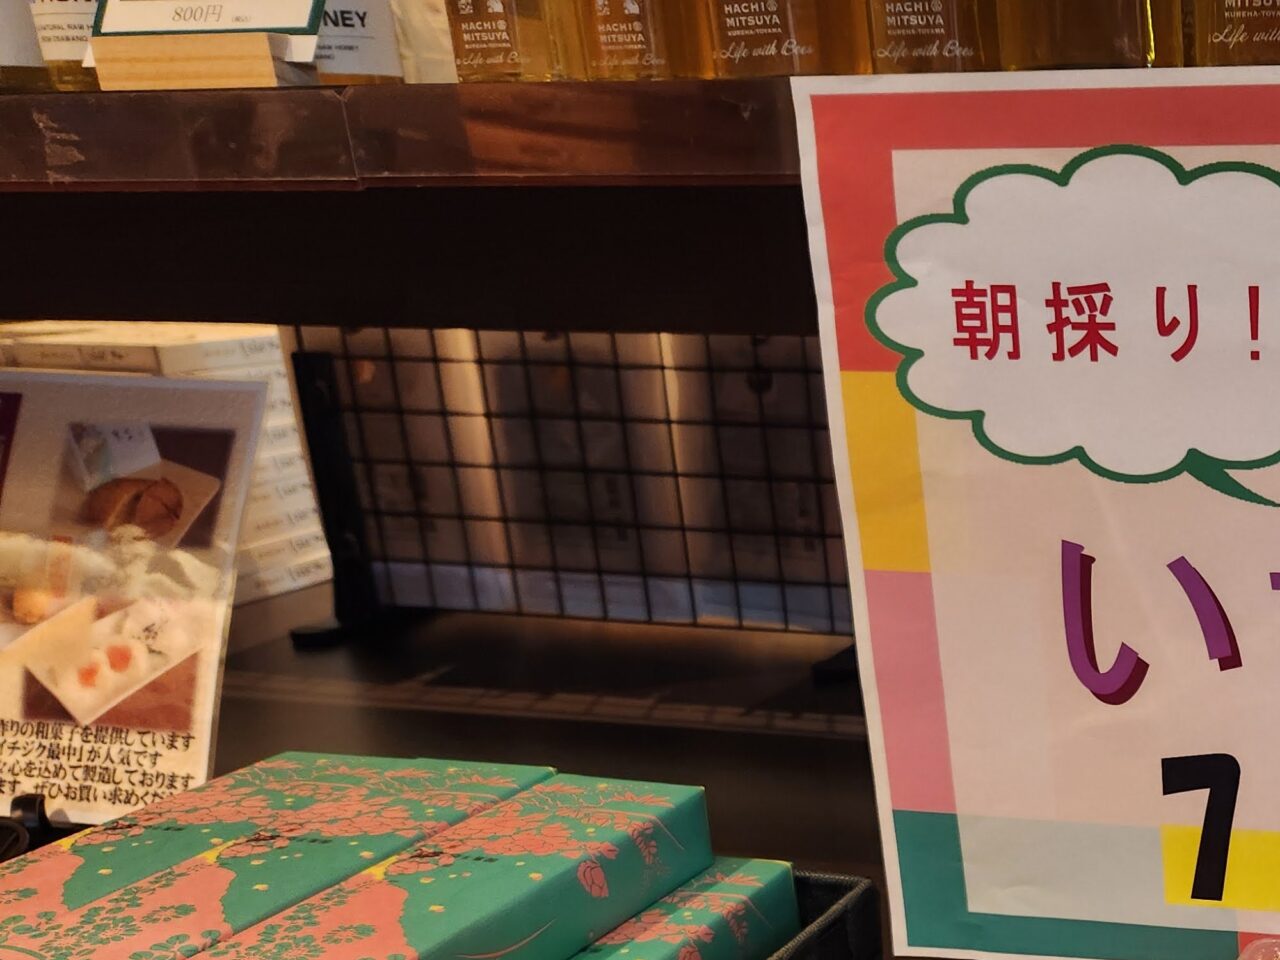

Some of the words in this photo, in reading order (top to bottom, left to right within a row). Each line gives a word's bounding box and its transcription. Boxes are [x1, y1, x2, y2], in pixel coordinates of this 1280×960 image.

[724, 2, 767, 14] HACHI
[885, 0, 930, 13] HACHI
[172, 5, 224, 23] 800円
[886, 14, 944, 27] MITSUYA
[461, 21, 497, 31] HACHI
[598, 23, 632, 33] HACHI
[726, 15, 781, 28] MITSUYA
[463, 32, 510, 42] MITSUYA
[600, 34, 645, 44] MITSUYA
[1212, 23, 1249, 49] Life
[720, 42, 748, 64] Life
[752, 39, 777, 57] with
[877, 42, 905, 65] Life
[911, 39, 938, 57] with
